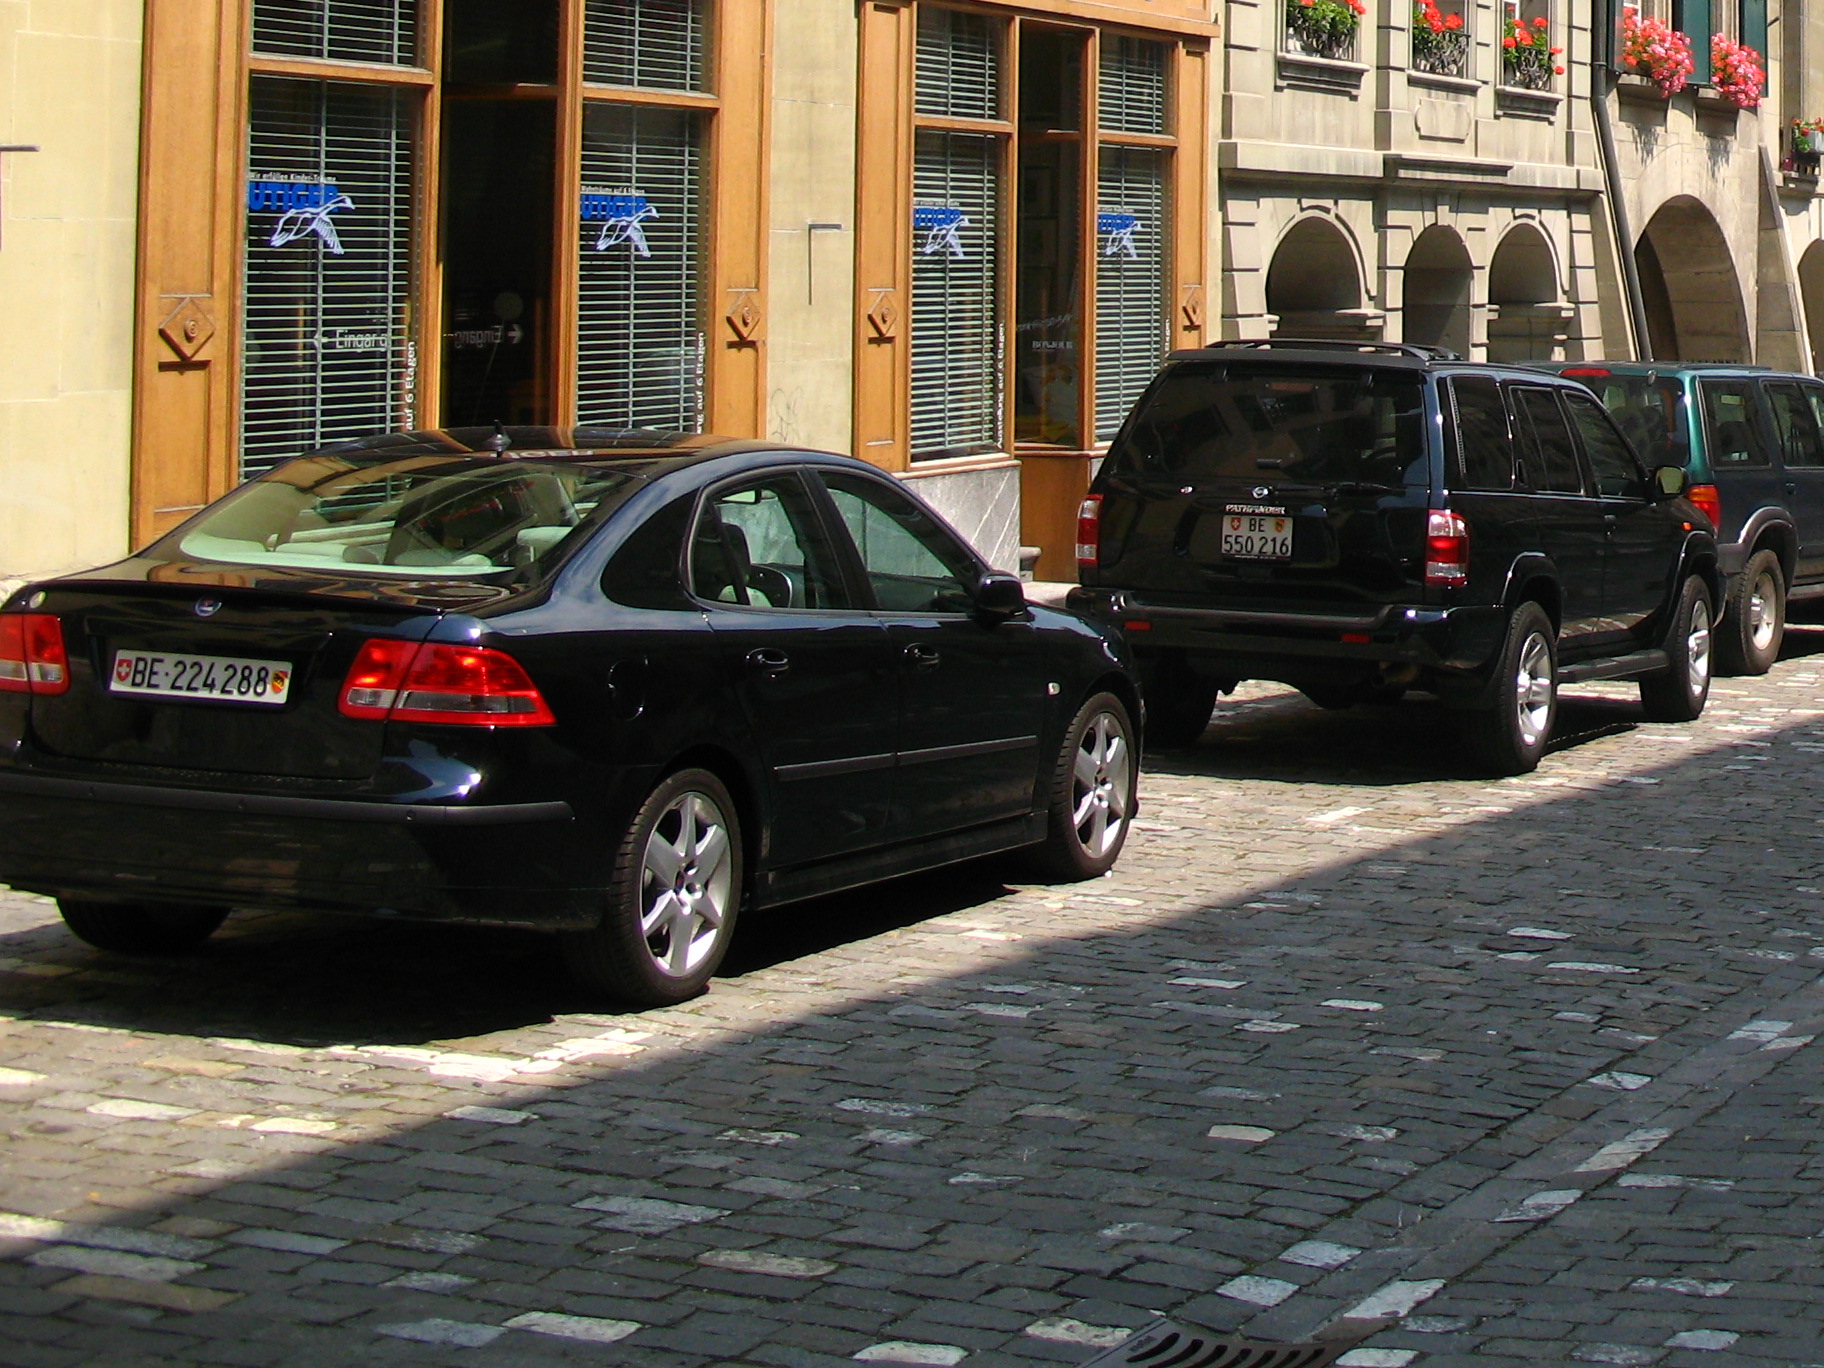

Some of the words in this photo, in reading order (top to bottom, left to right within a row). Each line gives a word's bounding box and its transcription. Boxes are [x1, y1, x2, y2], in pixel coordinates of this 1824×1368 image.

[247, 181, 339, 213] UTIGER
[580, 194, 648, 221] UTIGER
[405, 341, 417, 389] Etagen
[696, 332, 706, 374] Etagen
[405, 393, 414, 403] 6
[404, 408, 414, 431] auf
[1249, 518, 1266, 532] BE
